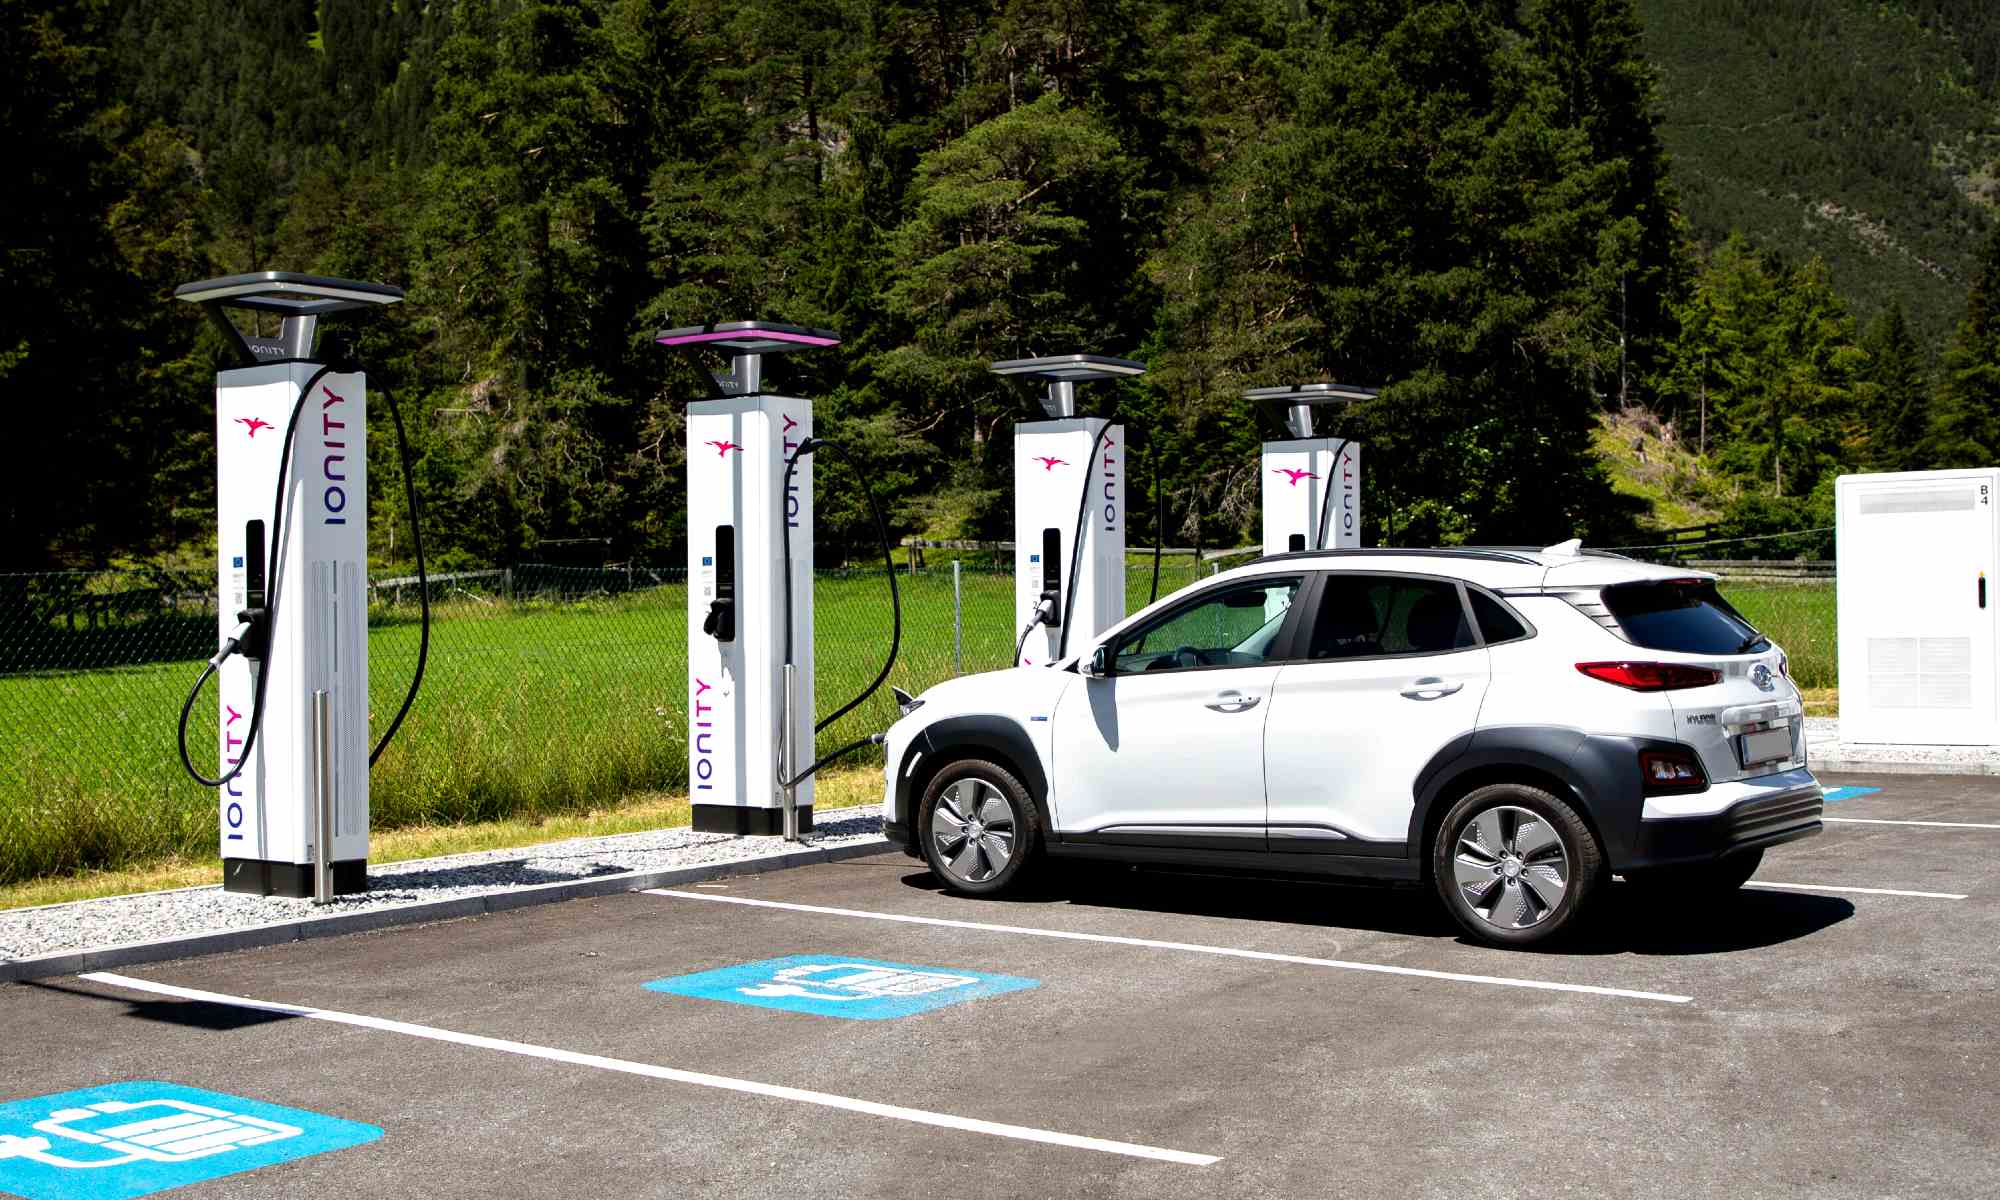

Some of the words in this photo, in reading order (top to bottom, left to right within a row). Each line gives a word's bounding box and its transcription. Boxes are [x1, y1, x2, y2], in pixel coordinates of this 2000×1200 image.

[323, 384, 345, 524] IONITY
[1104, 432, 1115, 531] IONITY
[1343, 452, 1353, 536] IONITY
[696, 678, 712, 790] IONITY
